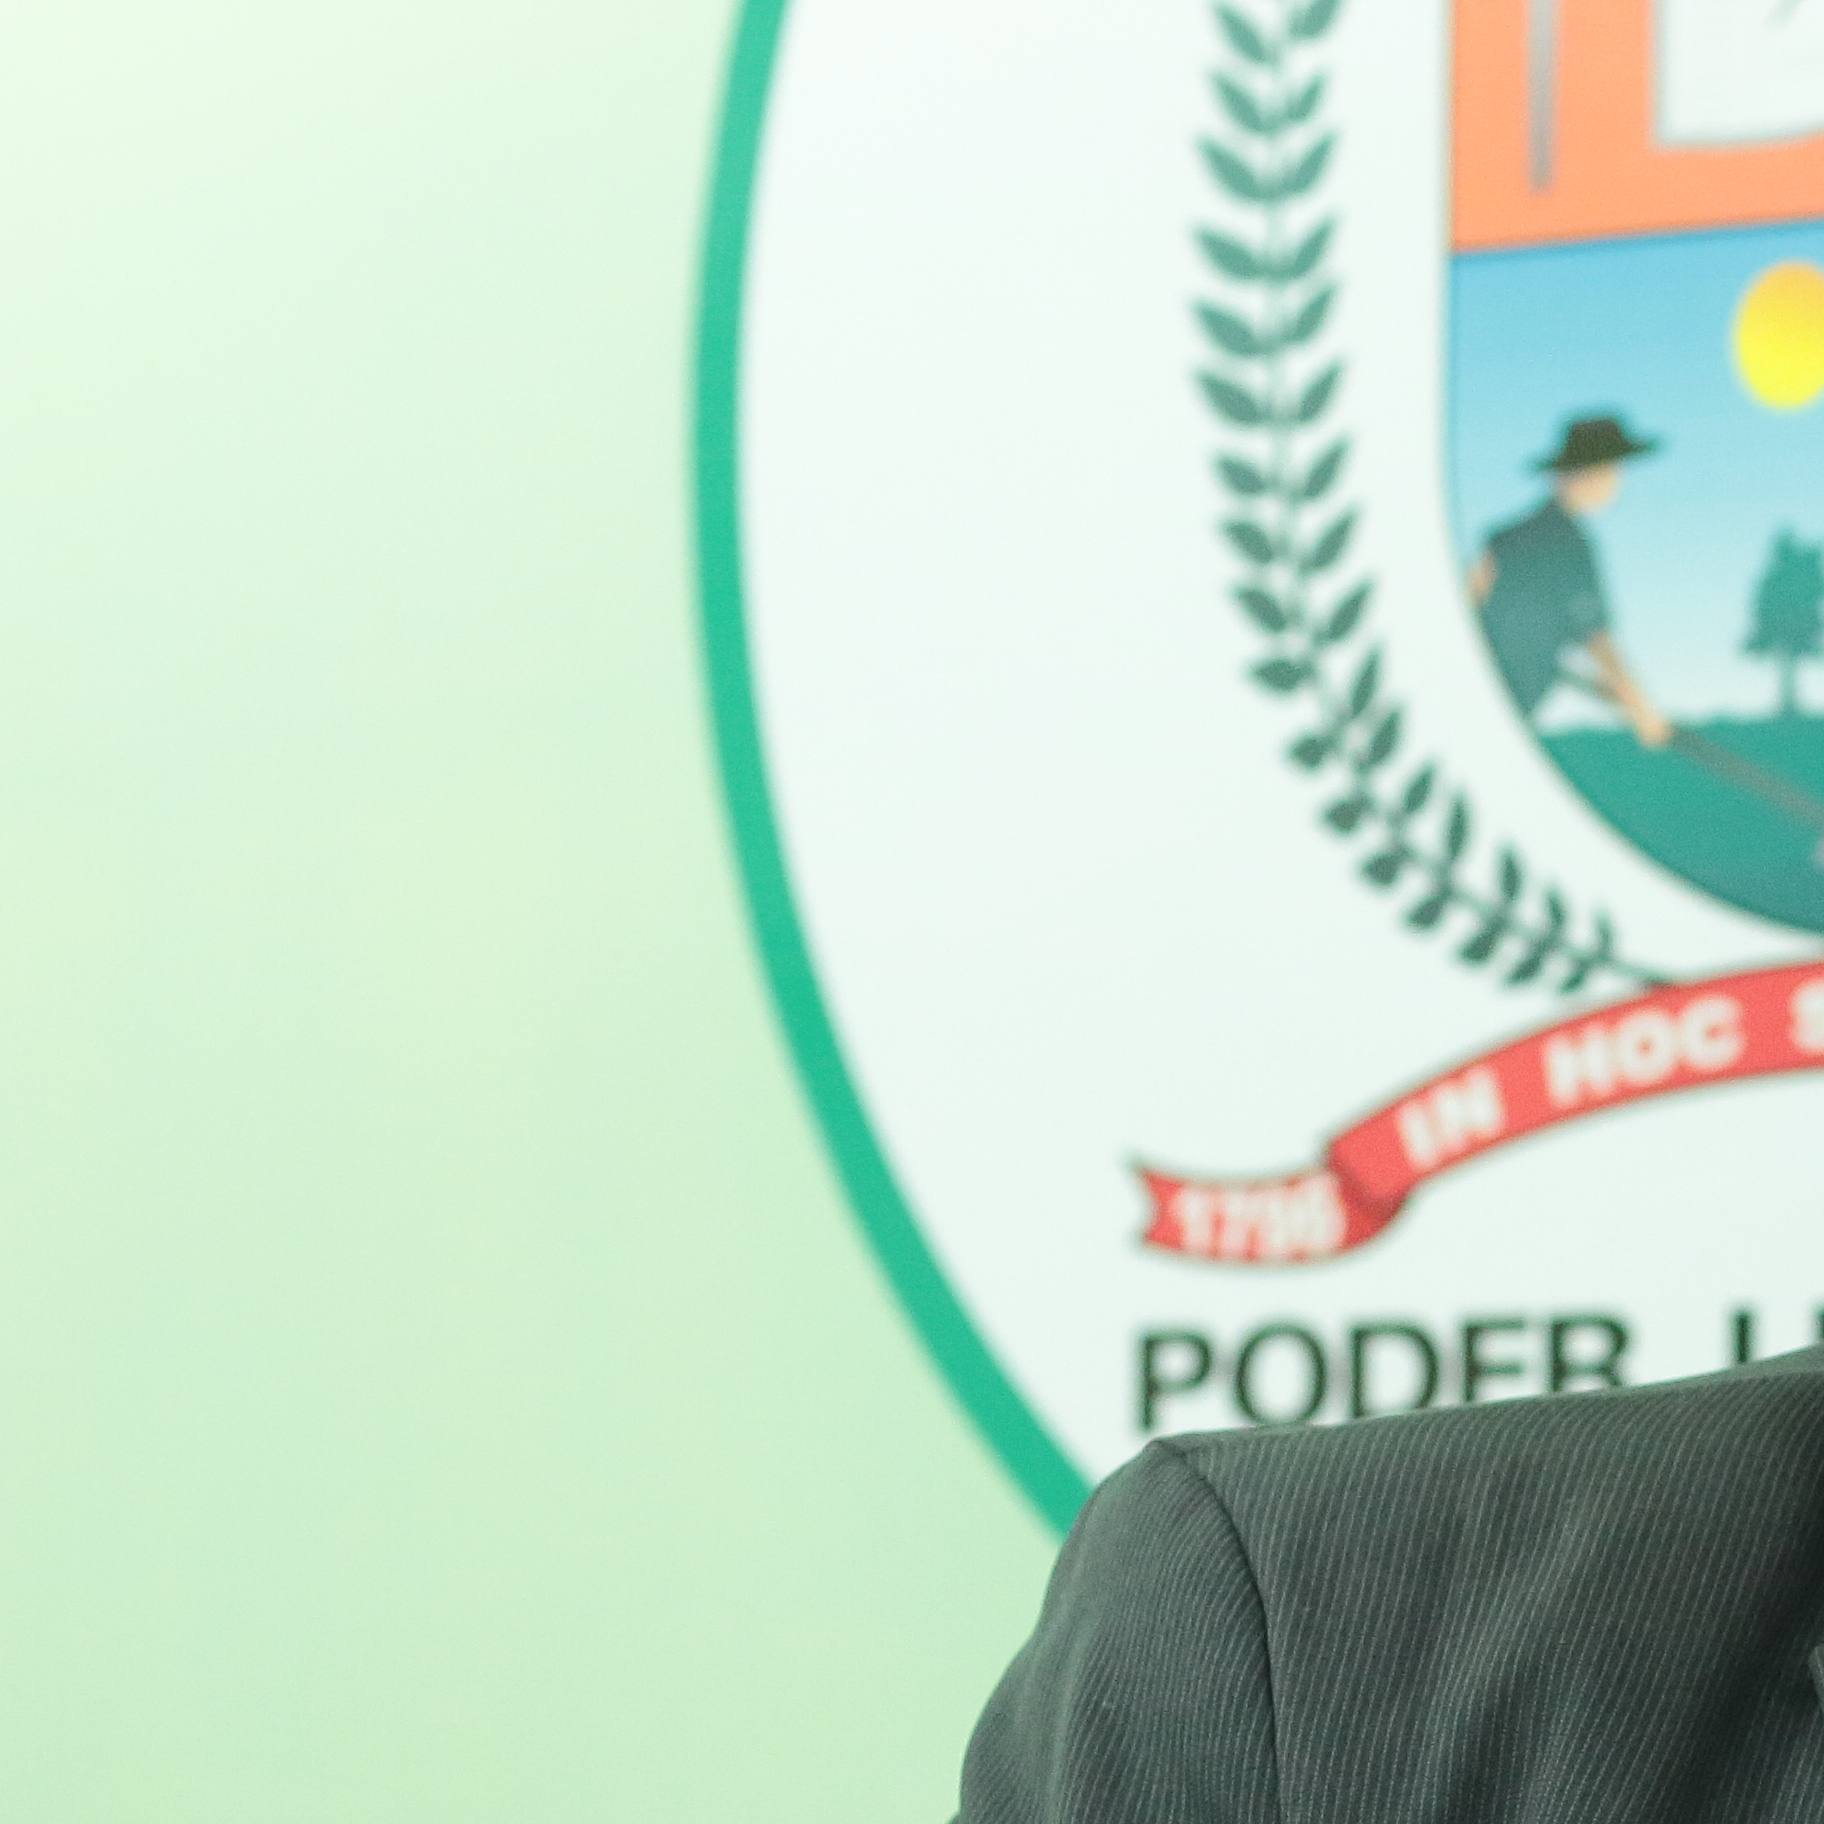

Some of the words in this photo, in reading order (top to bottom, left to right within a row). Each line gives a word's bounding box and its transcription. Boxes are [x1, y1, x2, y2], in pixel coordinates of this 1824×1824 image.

[1397, 1065, 1503, 1169] IN
[1543, 995, 1746, 1107] HOC
[1138, 1313, 1630, 1429] PODER
